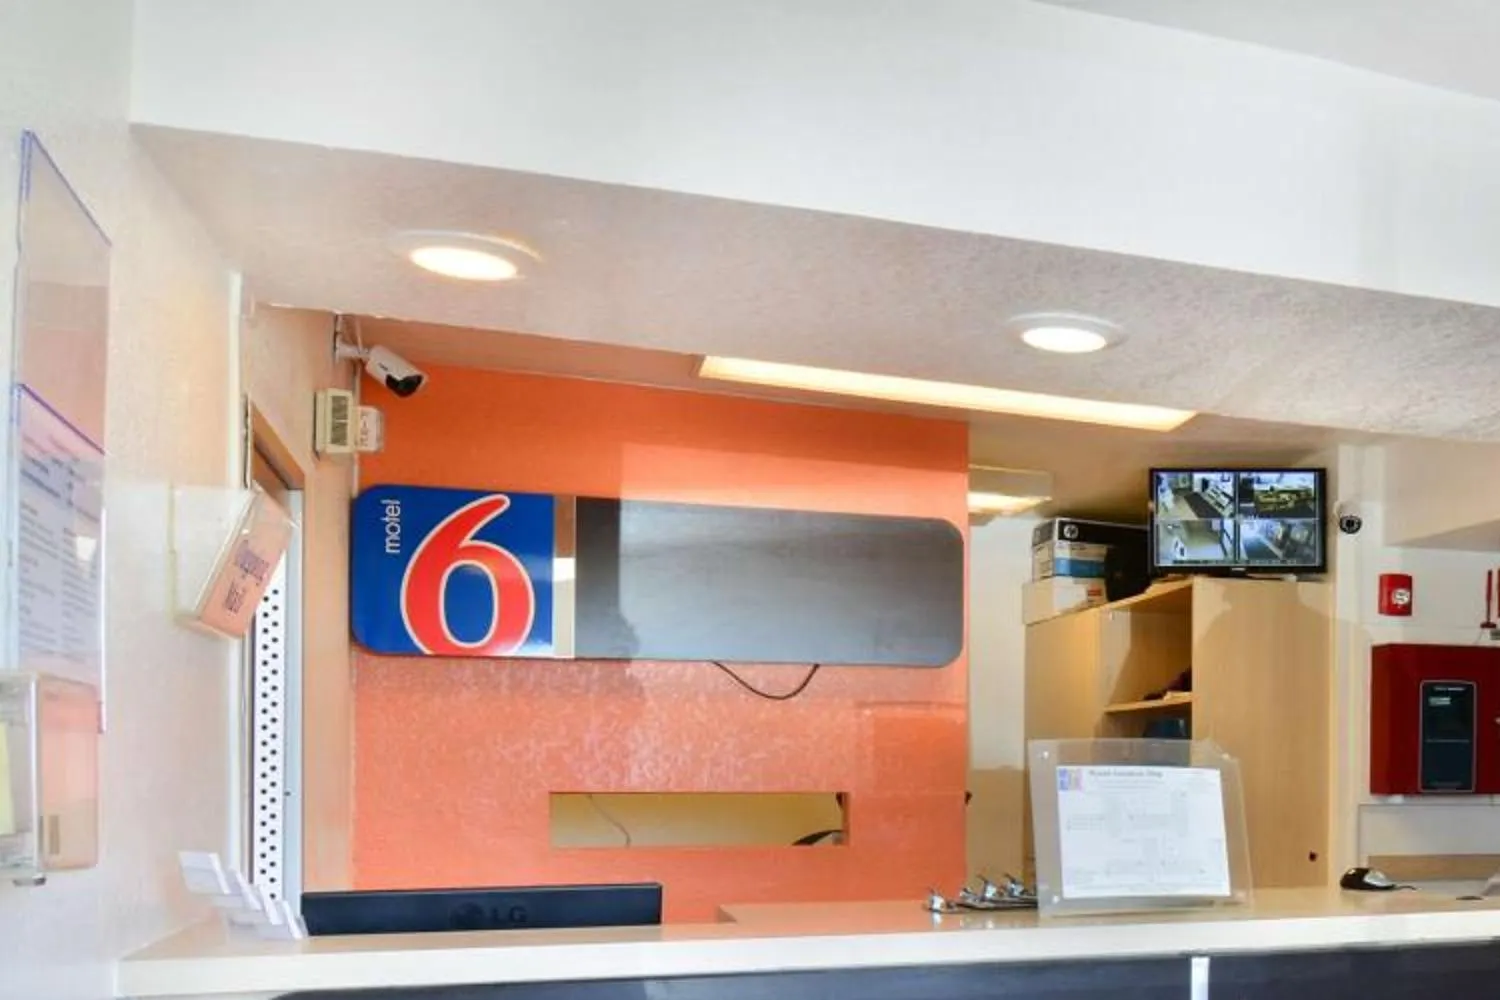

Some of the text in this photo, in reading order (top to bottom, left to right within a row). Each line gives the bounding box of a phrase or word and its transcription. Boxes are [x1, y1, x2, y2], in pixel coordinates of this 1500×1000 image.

[380, 499, 401, 554] motel
[400, 493, 536, 656] 6
[492, 907, 528, 923] LG
